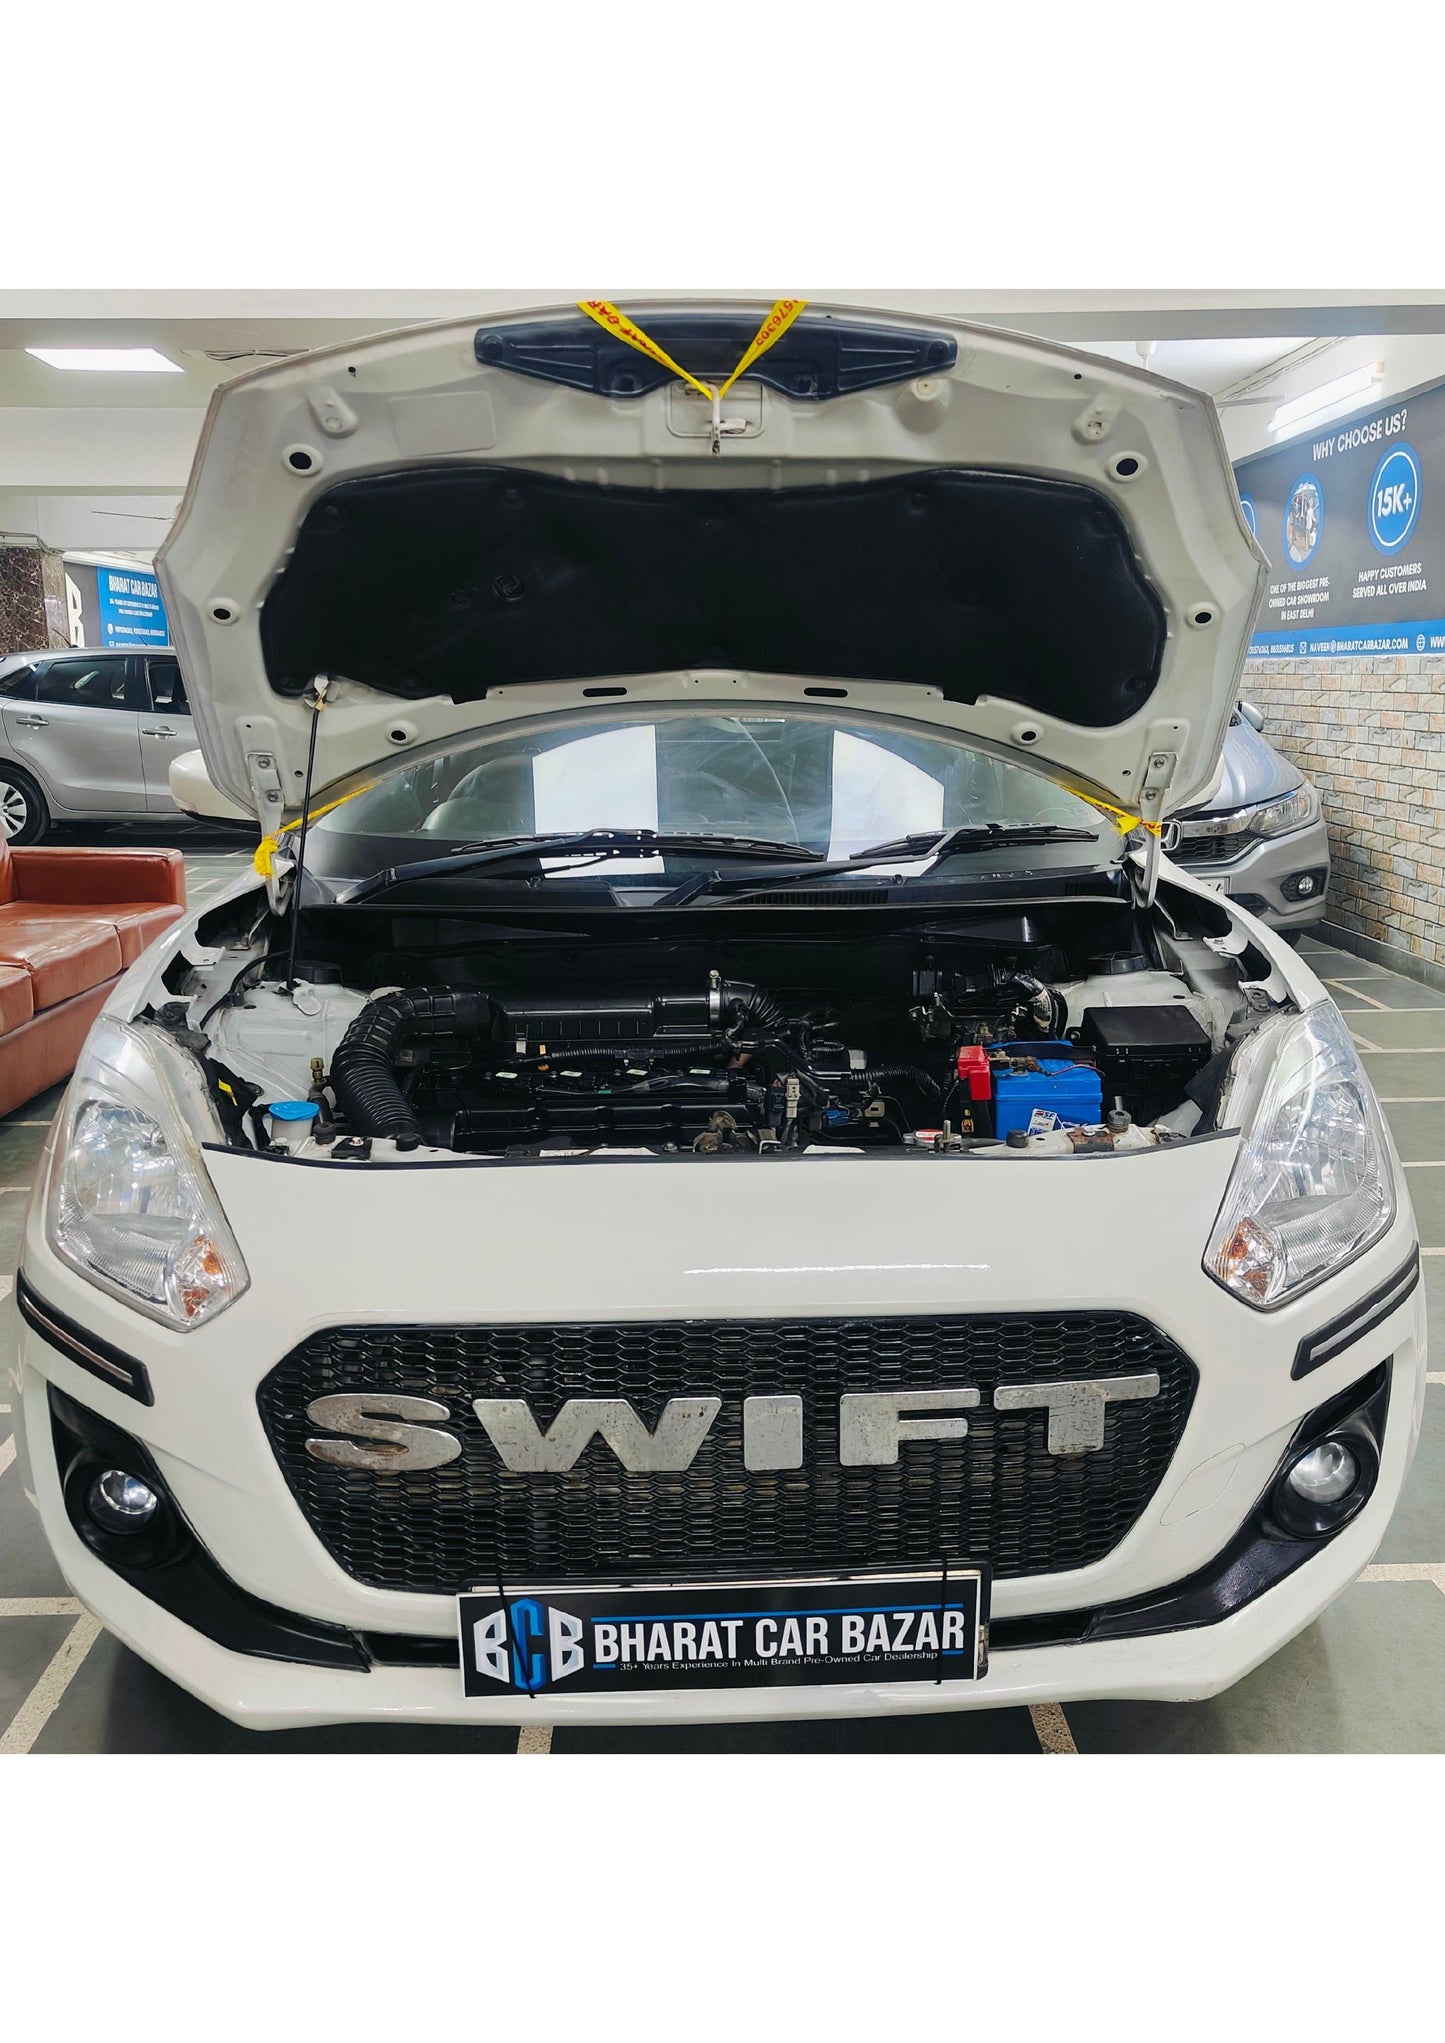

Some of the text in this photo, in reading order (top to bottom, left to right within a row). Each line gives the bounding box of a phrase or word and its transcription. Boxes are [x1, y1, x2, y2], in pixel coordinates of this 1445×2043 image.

[1313, 409, 1408, 461] WHY CHOOSE US?
[1377, 483, 1413, 518] 15K+
[1358, 562, 1422, 582] HAPPY CUSTOMERS
[109, 575, 158, 598] BHARAT CAR BAZAR
[1270, 577, 1330, 594] ONE OF THE BIGGEST PRE-
[1352, 578, 1427, 599] SERVED ALL OVER INDIA
[1269, 592, 1330, 608] OWNED CAR SHOWROOM
[1281, 608, 1315, 620] IN EAST DELHI
[1430, 635, 1445, 648] WW
[305, 1373, 1161, 1472] SWIFT
[473, 1598, 585, 1691] BCB
[593, 1610, 965, 1663] BHARAT CAR BAZAR
[620, 1651, 938, 1671] 35+ Years Experience In Multi Brand Pre-Owned Car Dealership
